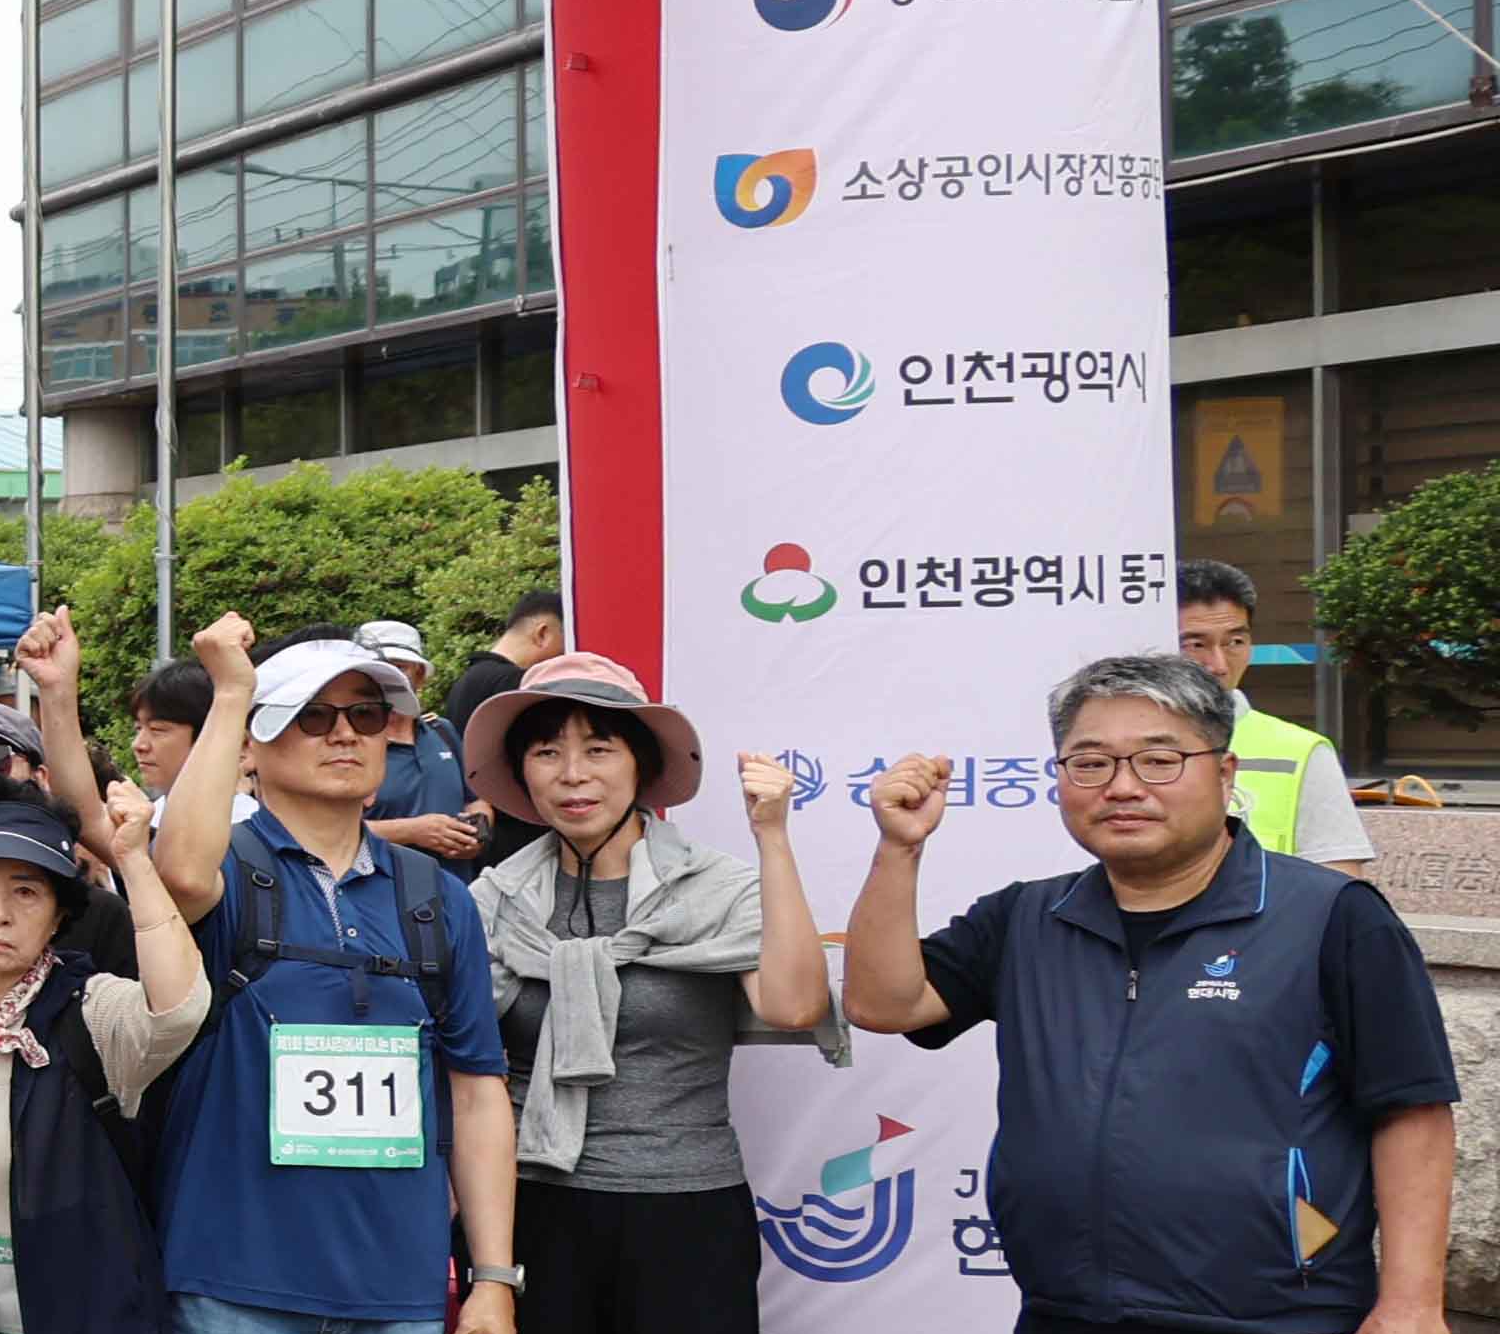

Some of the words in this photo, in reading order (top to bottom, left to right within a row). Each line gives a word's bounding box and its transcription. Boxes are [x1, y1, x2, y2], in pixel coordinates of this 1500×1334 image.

[899, 350, 1148, 405] 인천광역시
[859, 554, 1106, 610] 인천광역시
[1119, 552, 1165, 605] 동구
[303, 1069, 396, 1117] 311
